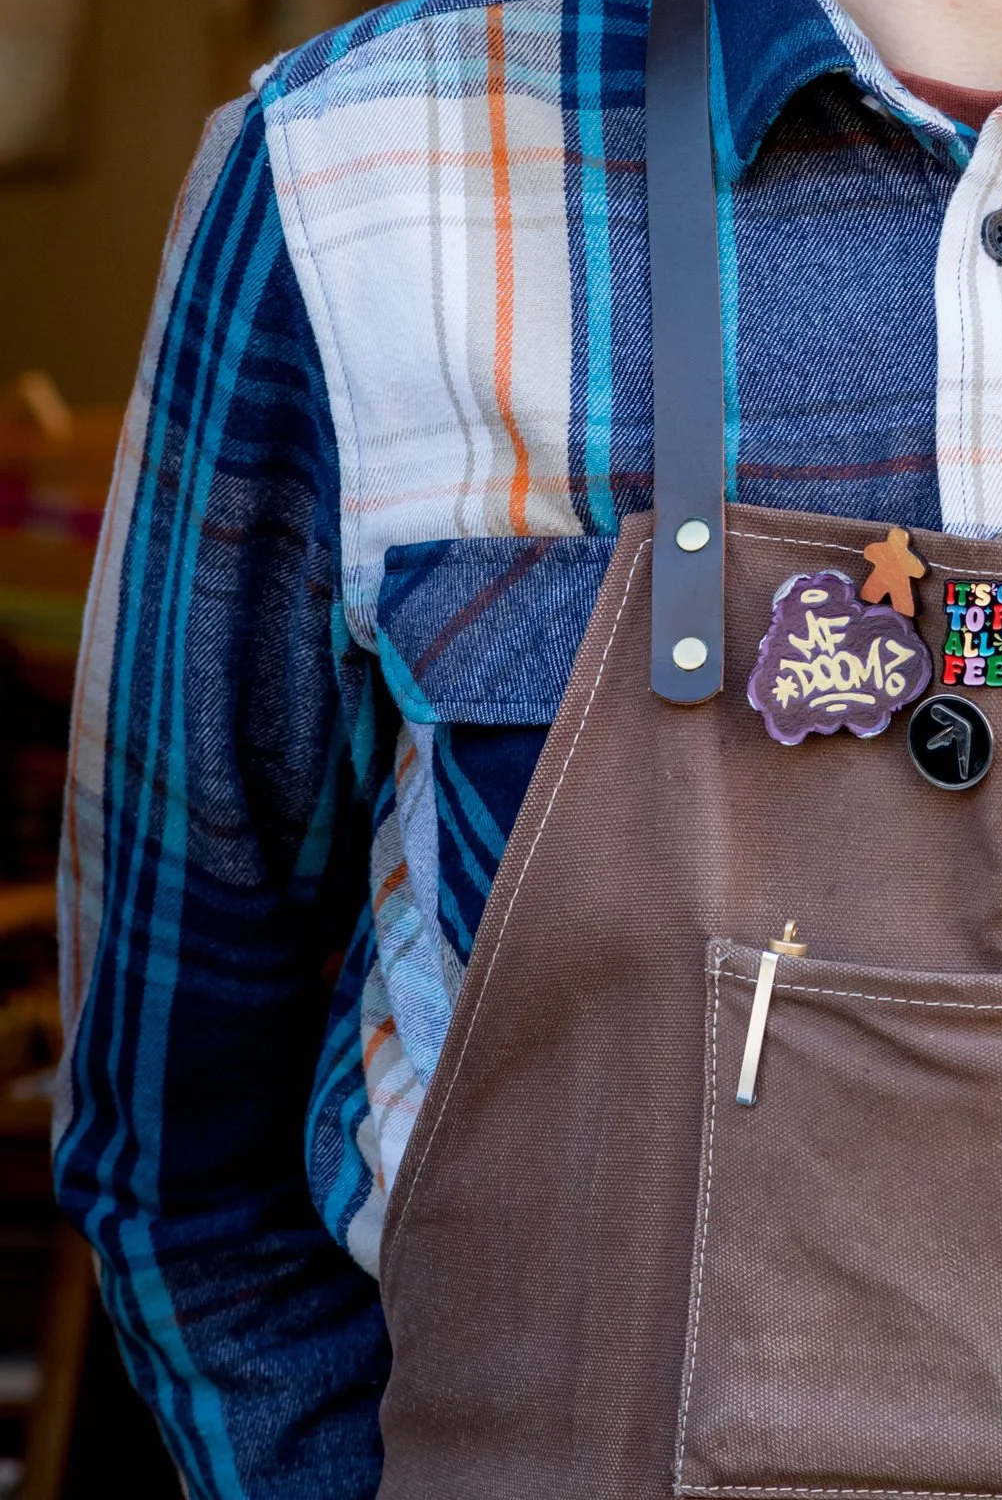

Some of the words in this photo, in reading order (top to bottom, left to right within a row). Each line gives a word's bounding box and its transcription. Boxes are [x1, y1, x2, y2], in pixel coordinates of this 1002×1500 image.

[946, 605, 985, 632] TO
[788, 610, 850, 660] MF
[944, 631, 995, 657] ALL
